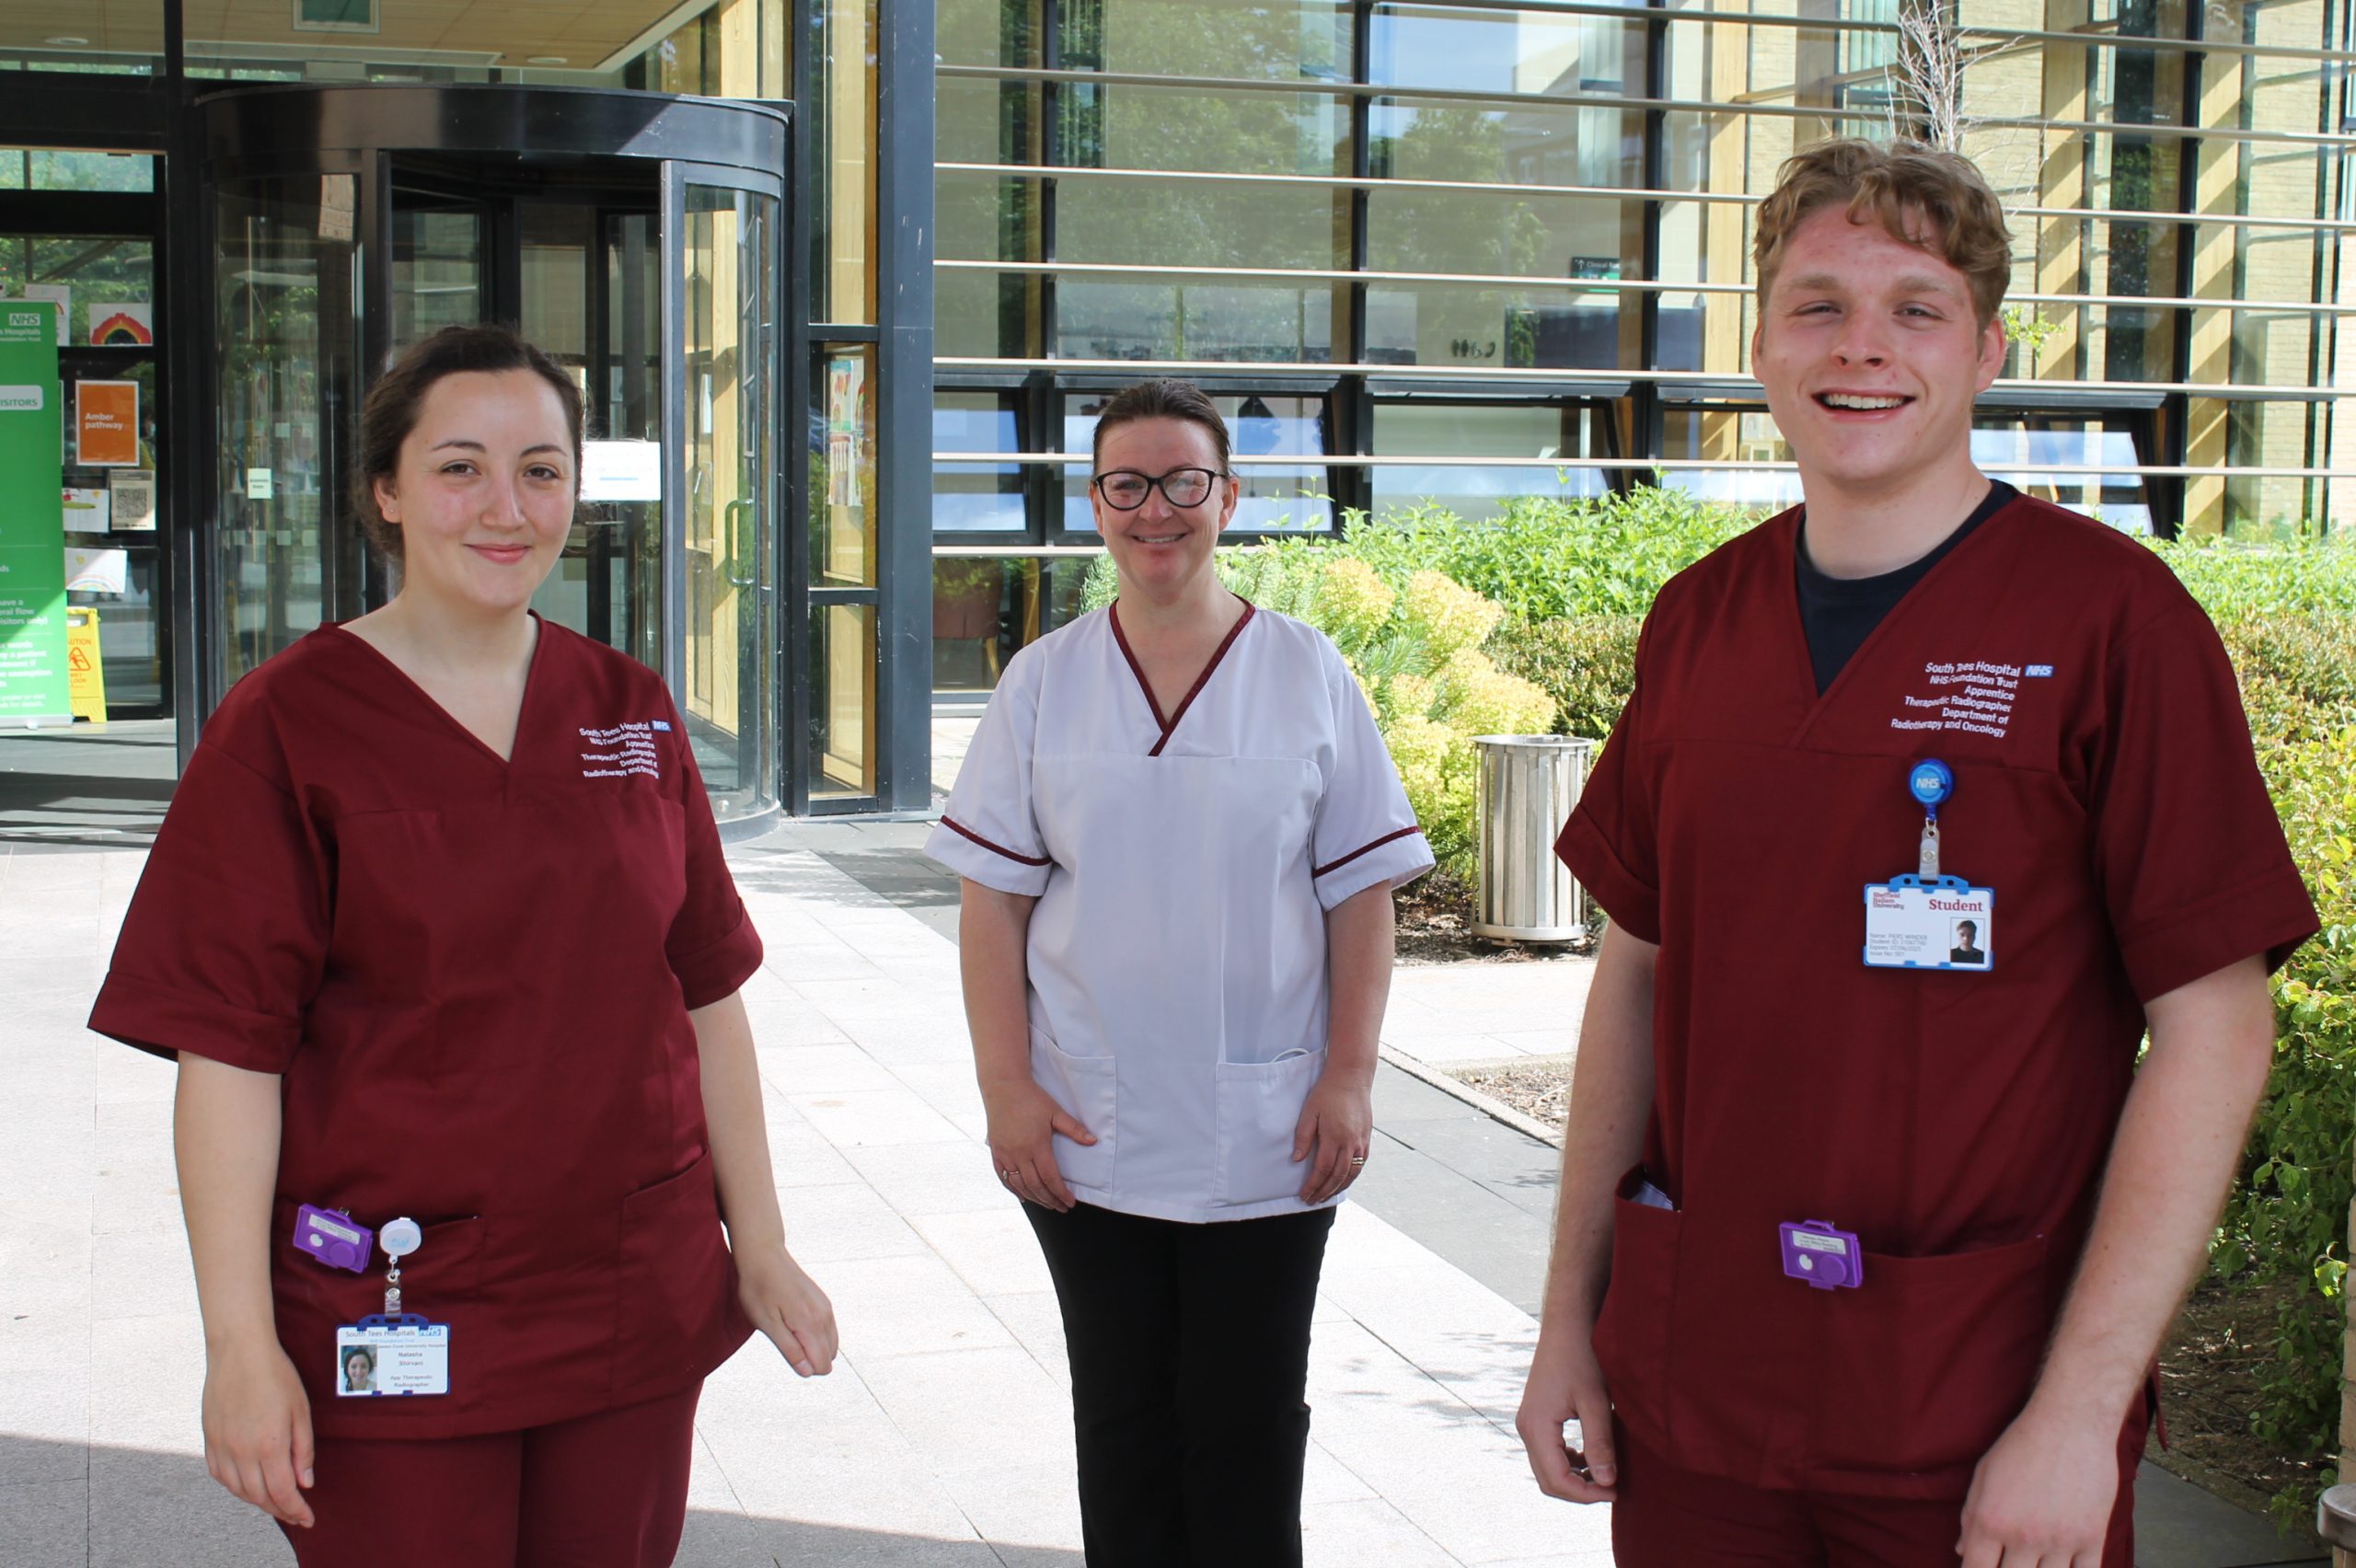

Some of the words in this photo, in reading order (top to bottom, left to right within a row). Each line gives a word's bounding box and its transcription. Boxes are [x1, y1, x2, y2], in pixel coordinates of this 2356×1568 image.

[11, 315, 39, 325] NHS
[0, 398, 38, 407] ISITORS
[85, 412, 114, 421] Amber
[85, 421, 123, 431] pathway
[1925, 662, 1954, 674] South
[1975, 661, 2021, 677] Hospital
[2026, 665, 2052, 676] NHS
[1929, 674, 1949, 685] NHS
[1995, 676, 2018, 689] Trust
[1964, 685, 2015, 701] Apprentice
[1950, 695, 2012, 712] Radiographer
[1942, 707, 1996, 722] Department
[1997, 716, 2010, 725] of
[619, 722, 651, 732] Hospital
[1891, 719, 1944, 731] Radiotherapy
[1945, 720, 1961, 730] and
[1962, 722, 2005, 738] Oncology
[1916, 778, 1940, 789] NHS
[1929, 898, 1983, 912] Student
[385, 1329, 415, 1337] Hospitals
